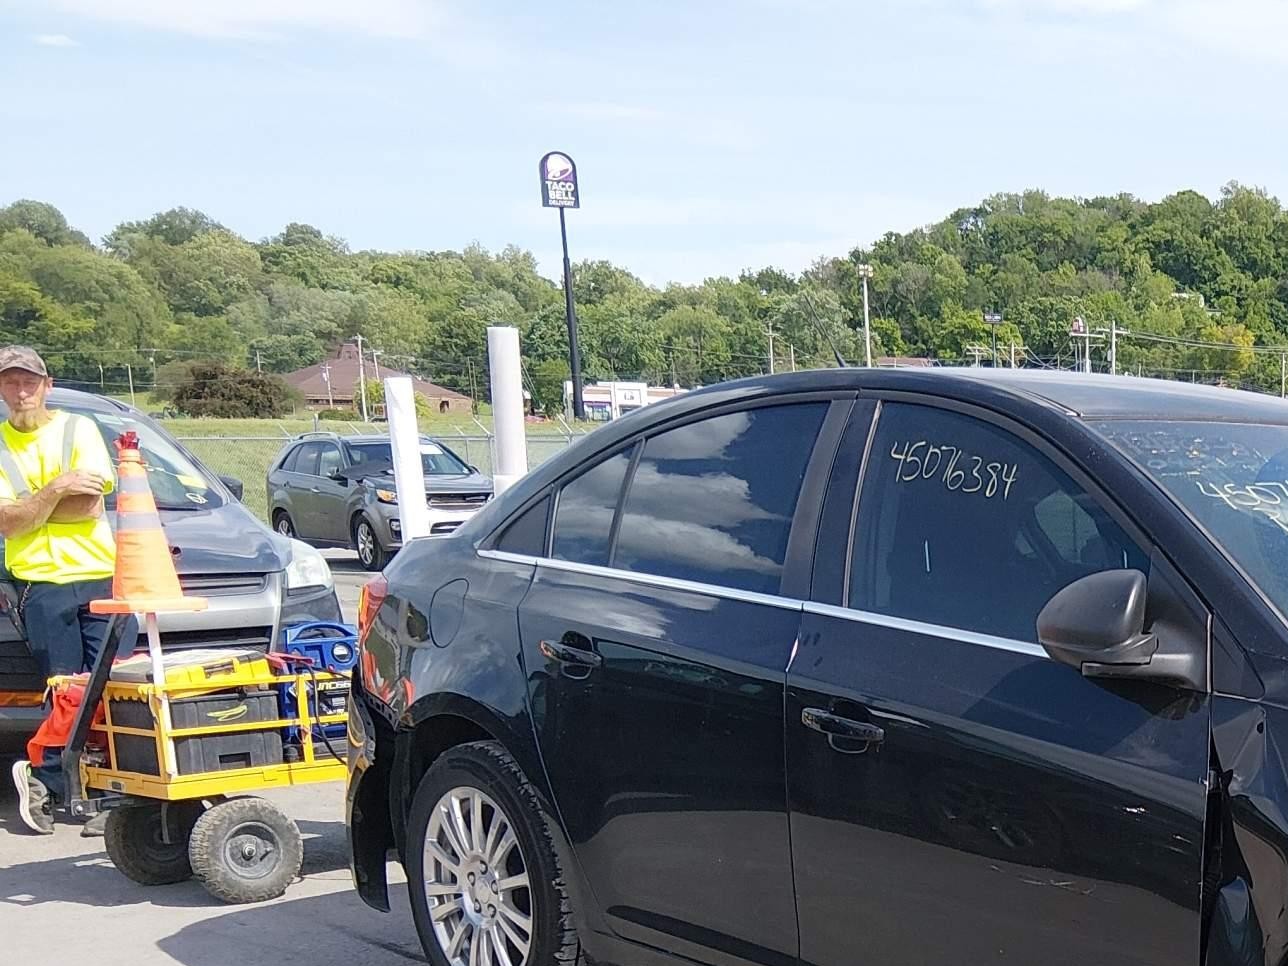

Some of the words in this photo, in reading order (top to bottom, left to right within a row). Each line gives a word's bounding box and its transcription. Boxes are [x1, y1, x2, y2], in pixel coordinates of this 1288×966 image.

[545, 180, 575, 192] TACO
[548, 190, 576, 200] BELL
[890, 440, 1019, 501] 45076384
